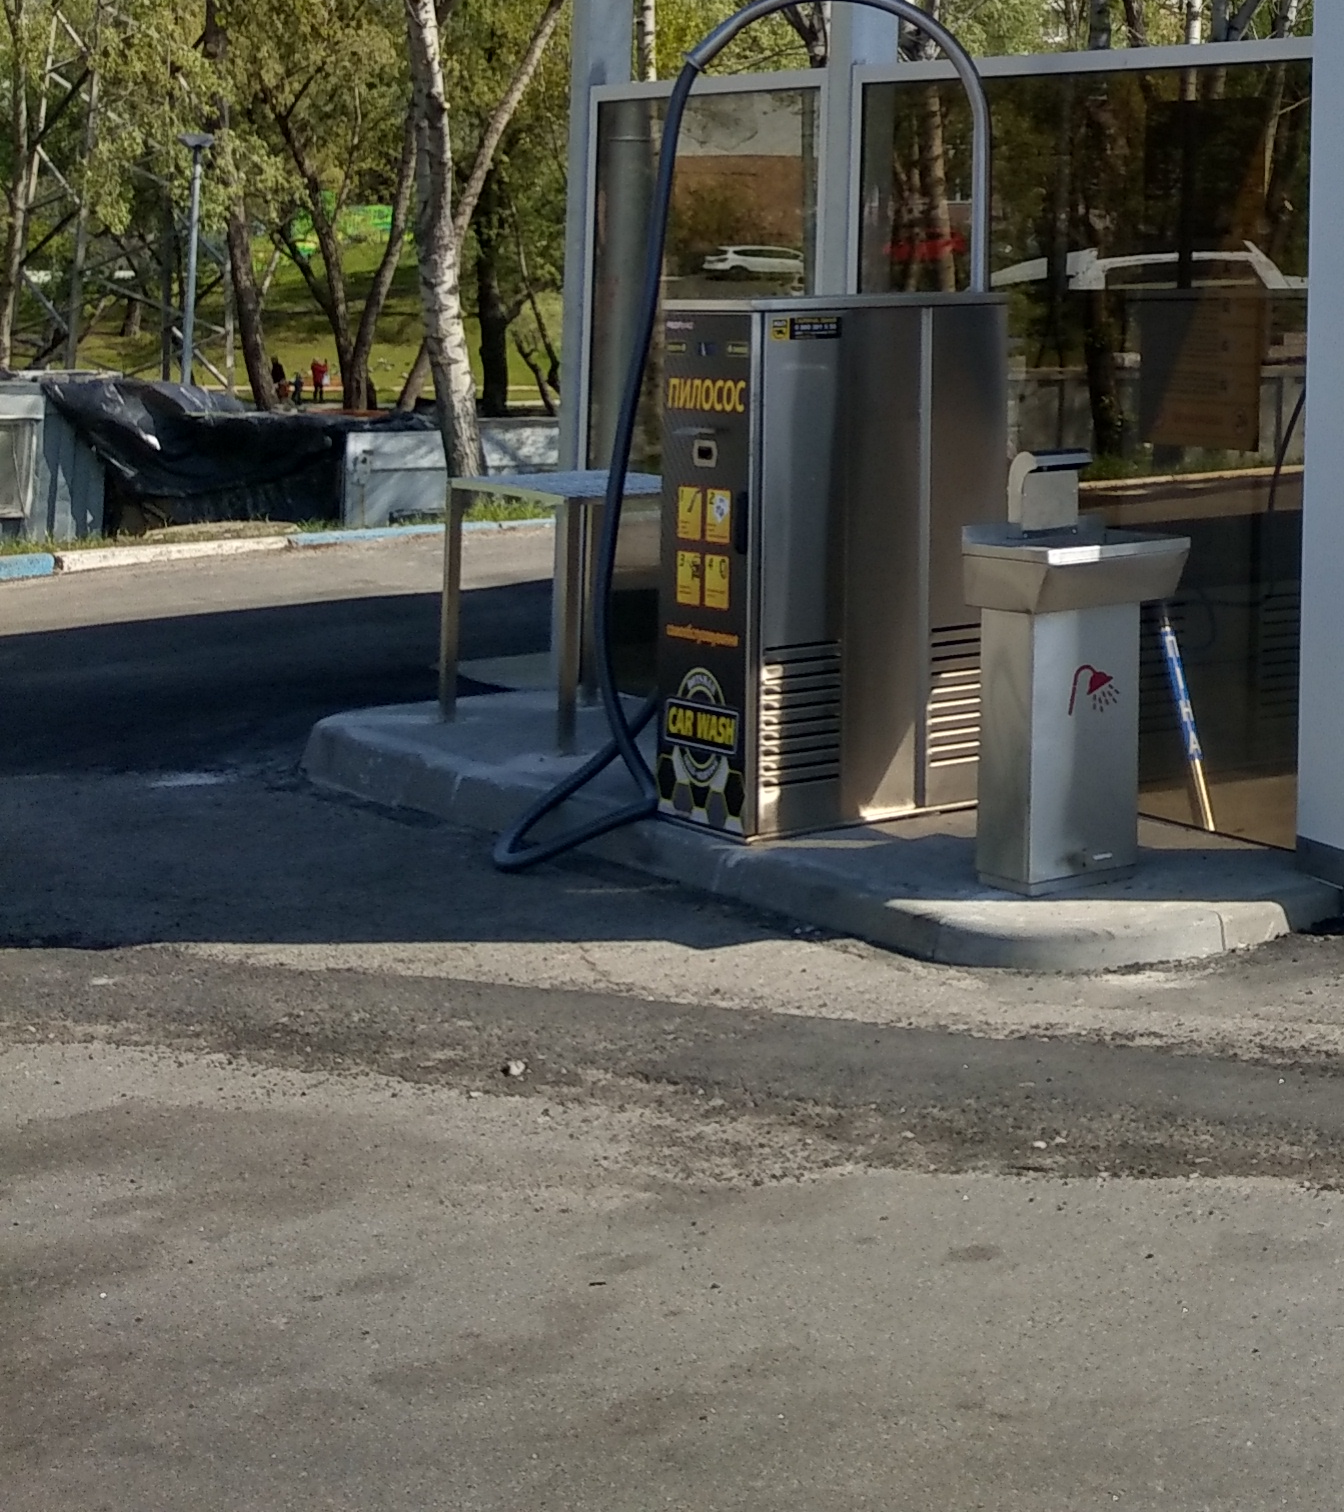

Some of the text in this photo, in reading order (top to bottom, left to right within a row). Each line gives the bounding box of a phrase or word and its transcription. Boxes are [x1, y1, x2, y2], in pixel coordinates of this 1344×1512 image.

[668, 377, 747, 413] ПИЛОСОС
[668, 706, 736, 747] CAR WASH
